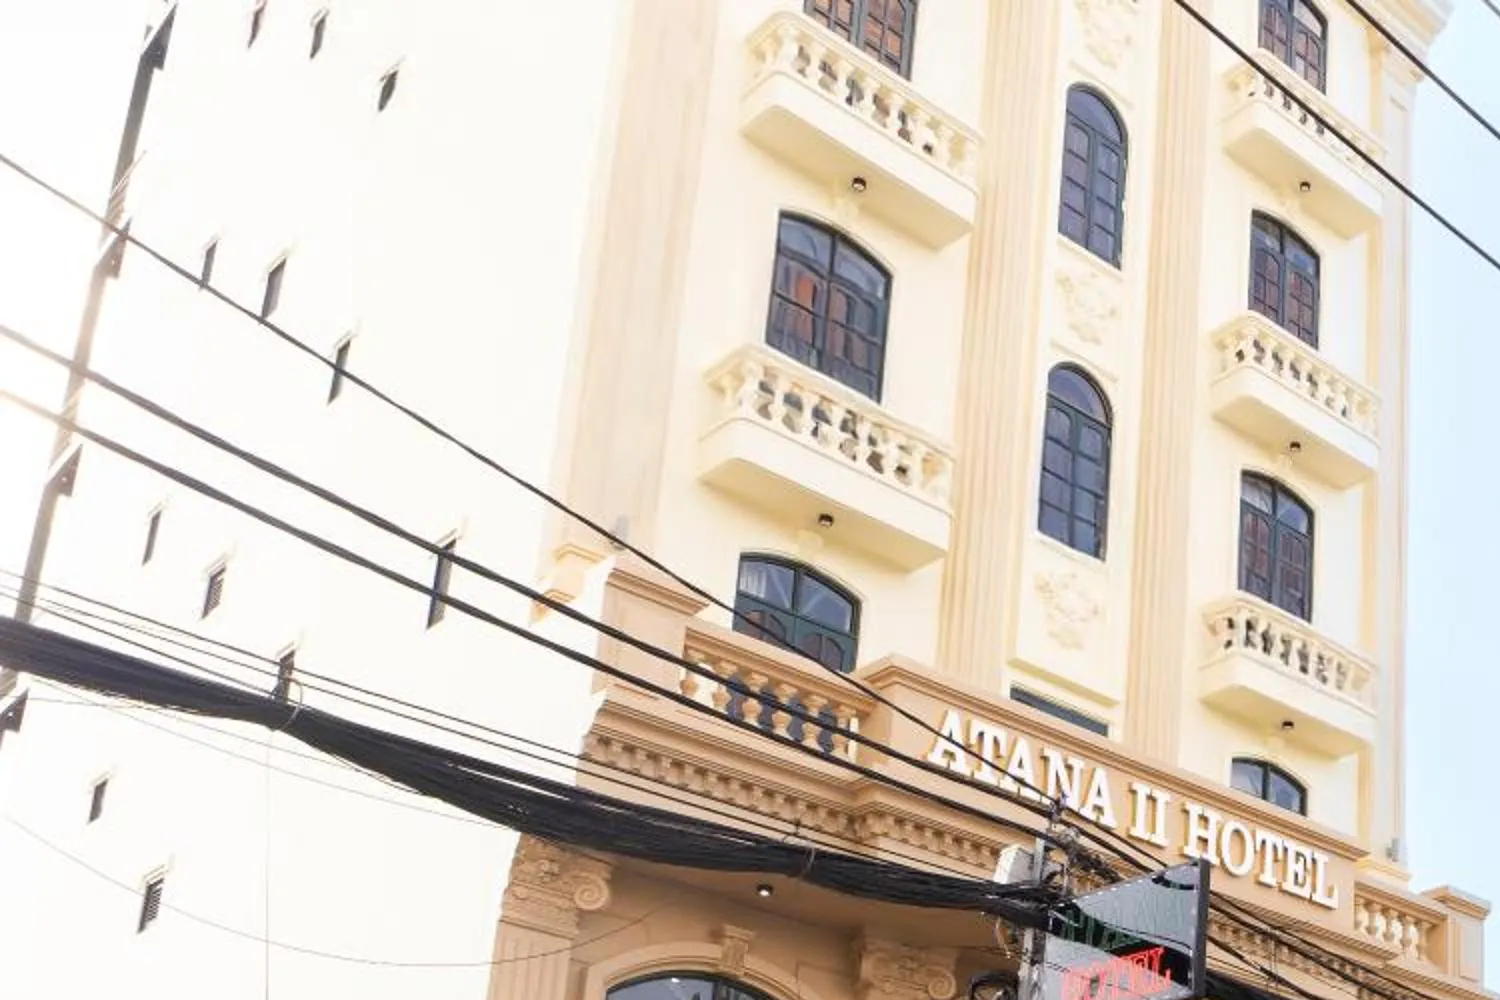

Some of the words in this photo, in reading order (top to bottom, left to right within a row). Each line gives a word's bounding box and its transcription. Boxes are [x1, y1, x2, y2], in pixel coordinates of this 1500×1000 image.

[927, 708, 1117, 830] ATANA
[1130, 782, 1170, 848] II
[1184, 801, 1340, 910] HOTEL
